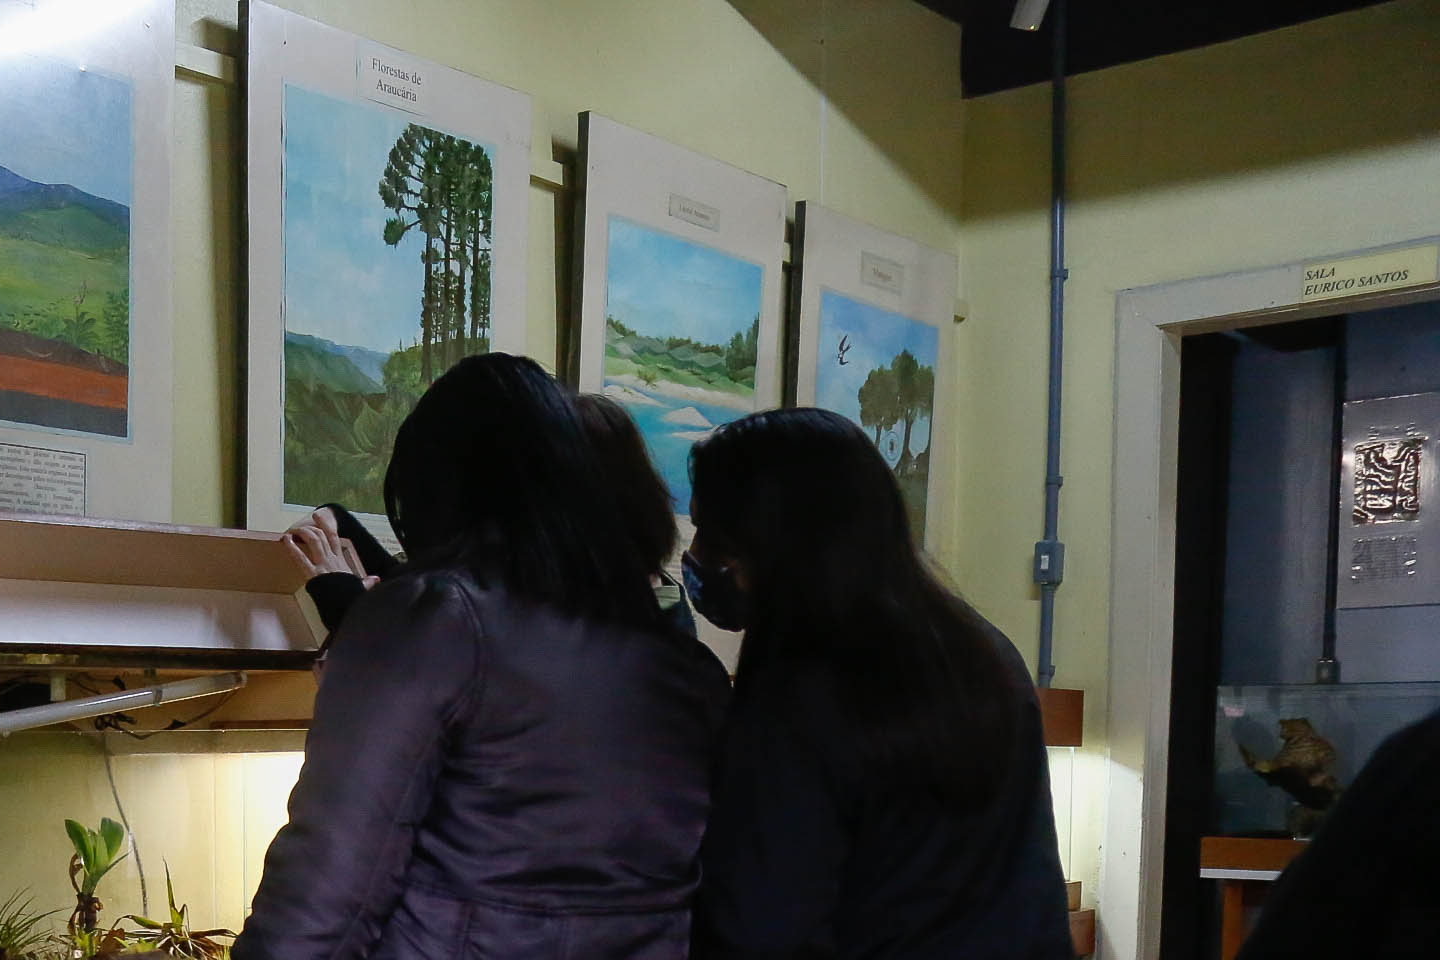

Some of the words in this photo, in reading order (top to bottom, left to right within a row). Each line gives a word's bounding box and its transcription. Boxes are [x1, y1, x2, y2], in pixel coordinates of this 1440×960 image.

[372, 58, 409, 81] Florestas
[412, 73, 421, 85] de
[376, 79, 417, 101] Araucária
[1304, 279, 1354, 295] EURICO
[1358, 270, 1408, 287] SANTOS
[1305, 268, 1335, 280] SALA
